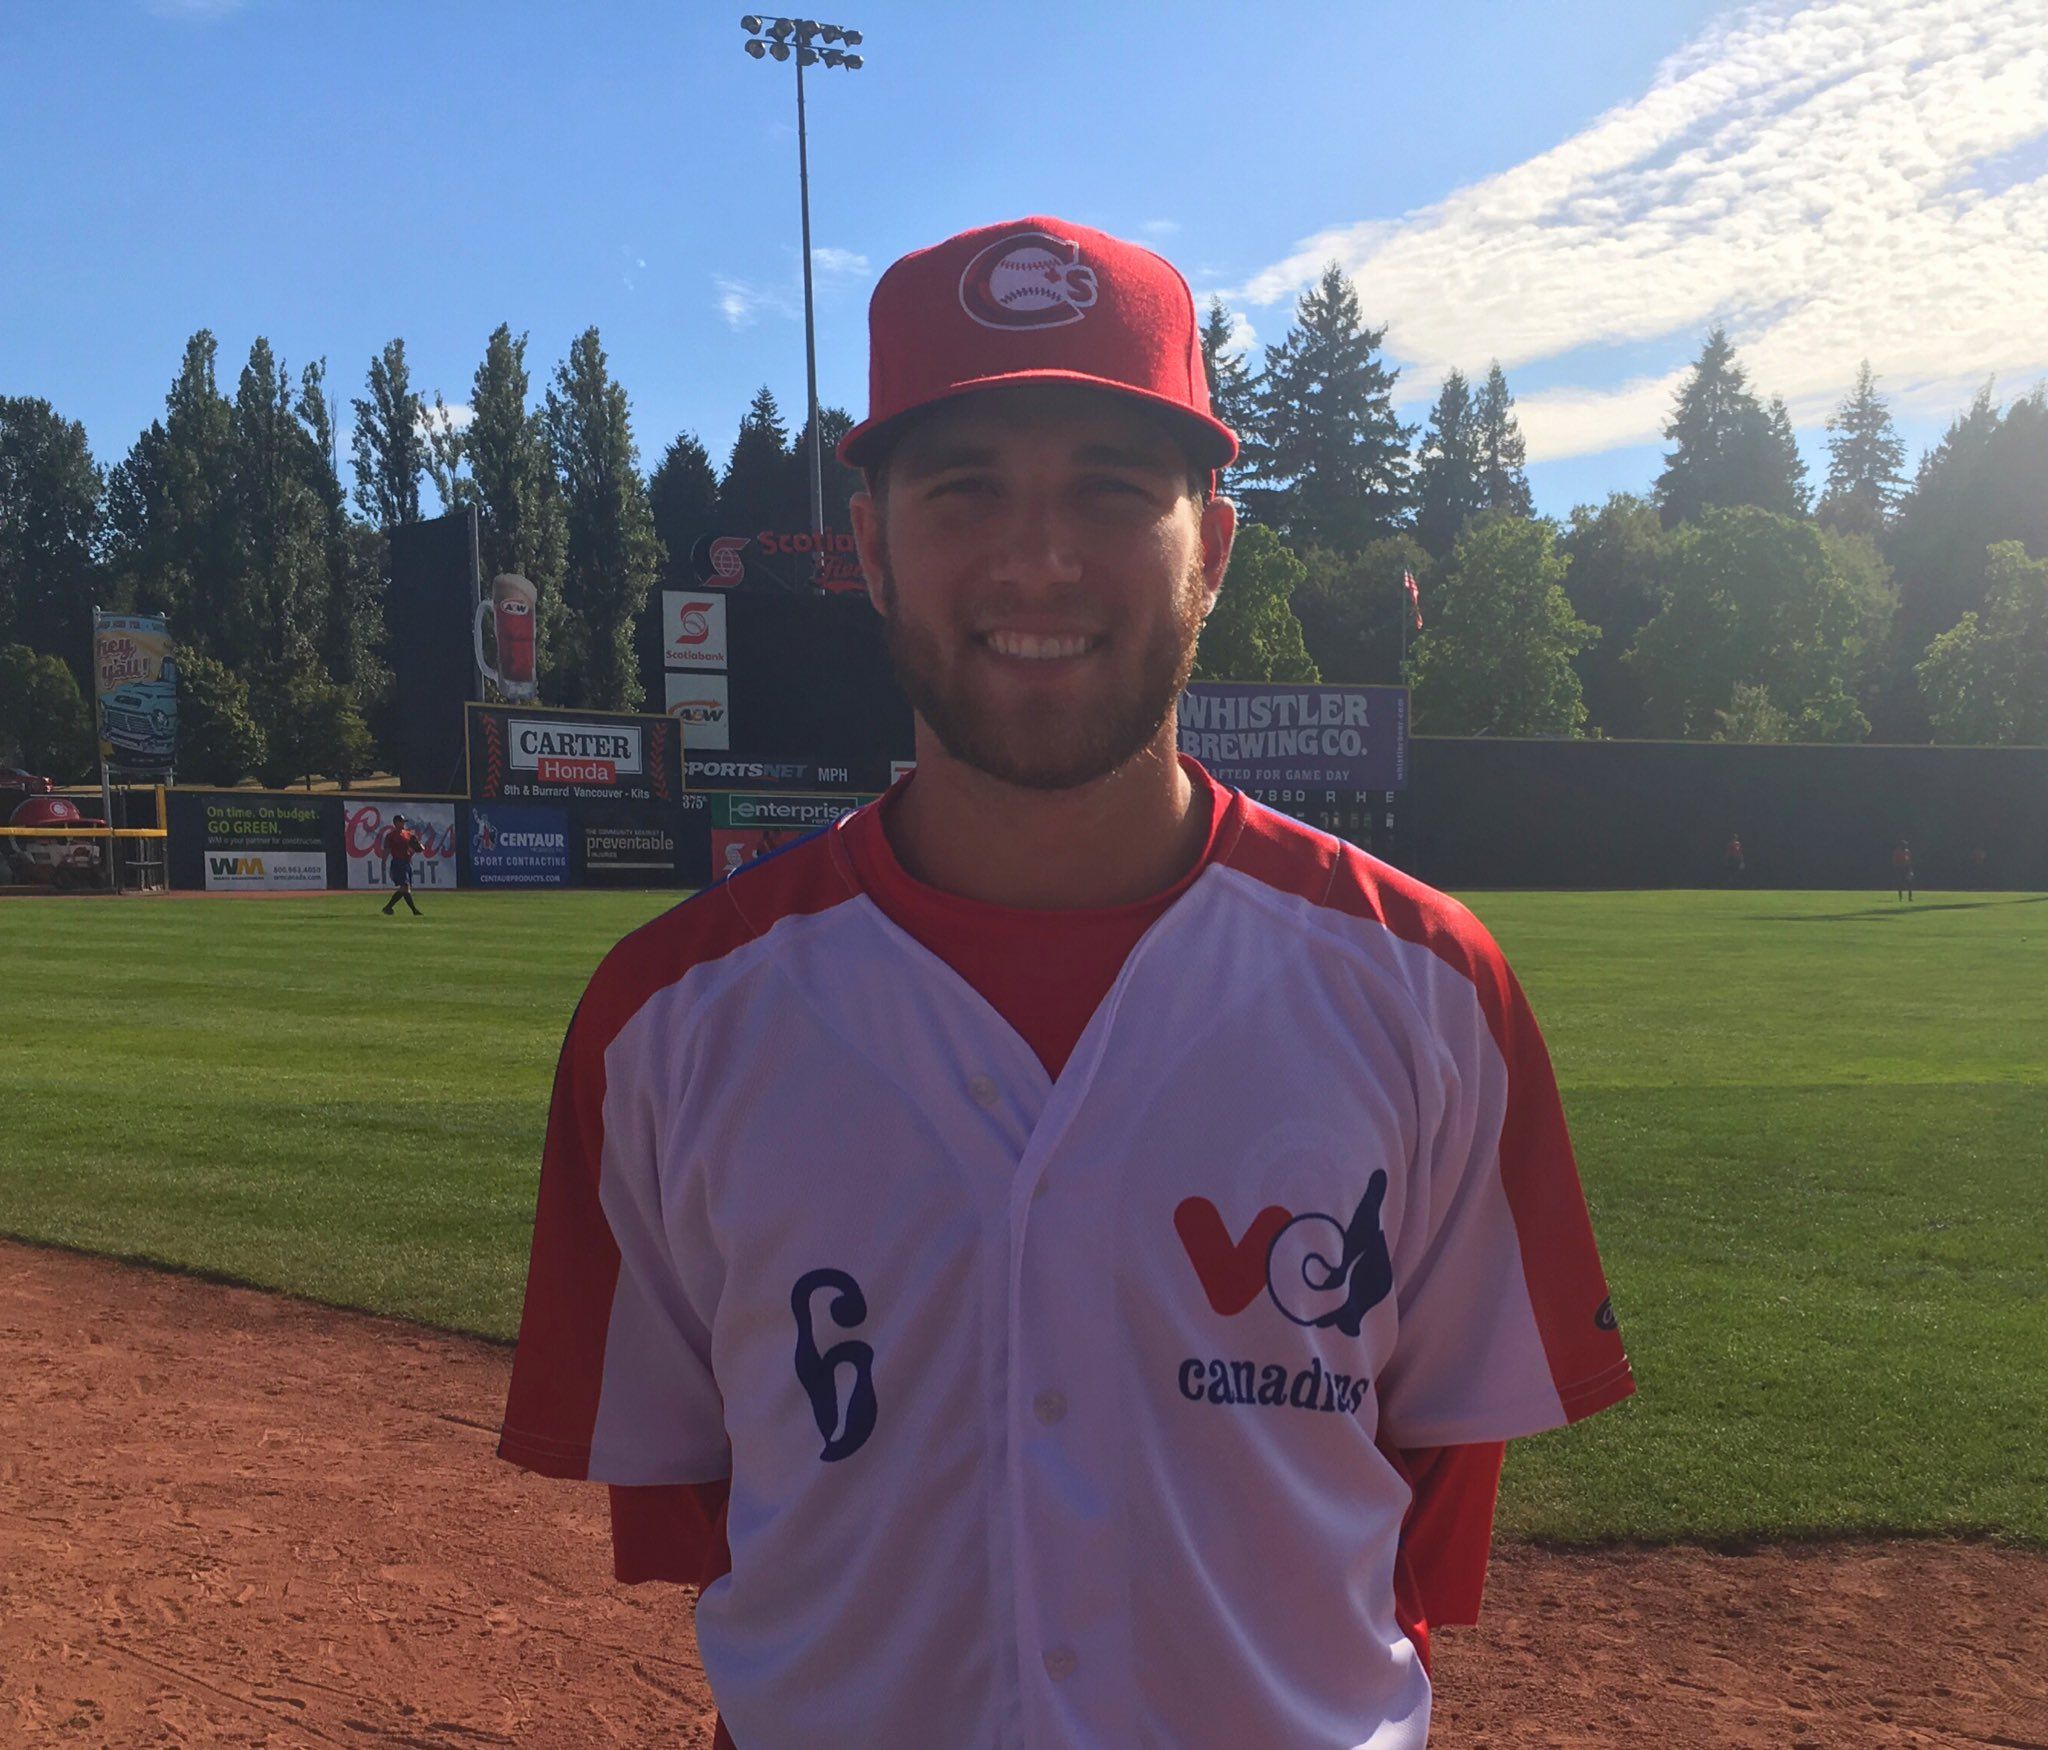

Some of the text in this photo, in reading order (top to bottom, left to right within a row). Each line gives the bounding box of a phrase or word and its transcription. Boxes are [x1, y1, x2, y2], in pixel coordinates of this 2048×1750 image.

[757, 526, 856, 555] Scotia
[665, 651, 725, 662] Scotiabank
[1178, 693, 1370, 730] WHISTLER
[519, 730, 632, 760] CARTER
[1180, 729, 1369, 762] BREWING CO.
[544, 761, 609, 781] Honda
[818, 767, 849, 783] MPH
[1256, 769, 1281, 781] FOR
[1286, 769, 1321, 781] GAME
[1326, 770, 1351, 782] DAY
[504, 785, 521, 796] 8th
[523, 786, 532, 796] &
[532, 785, 570, 797] Burrard
[574, 787, 624, 799] Vancouver
[632, 789, 651, 800] Kits
[207, 806, 320, 822] On time. On budget.
[208, 821, 282, 834] GO GREEN.
[499, 832, 565, 848] CENTAUR
[586, 830, 675, 858] preventable
[209, 857, 266, 876] WM
[474, 856, 567, 867] SPORT CONTRACTING
[367, 861, 439, 885] LIHT
[480, 874, 561, 883] CENTAURPRODUCTS.COM
